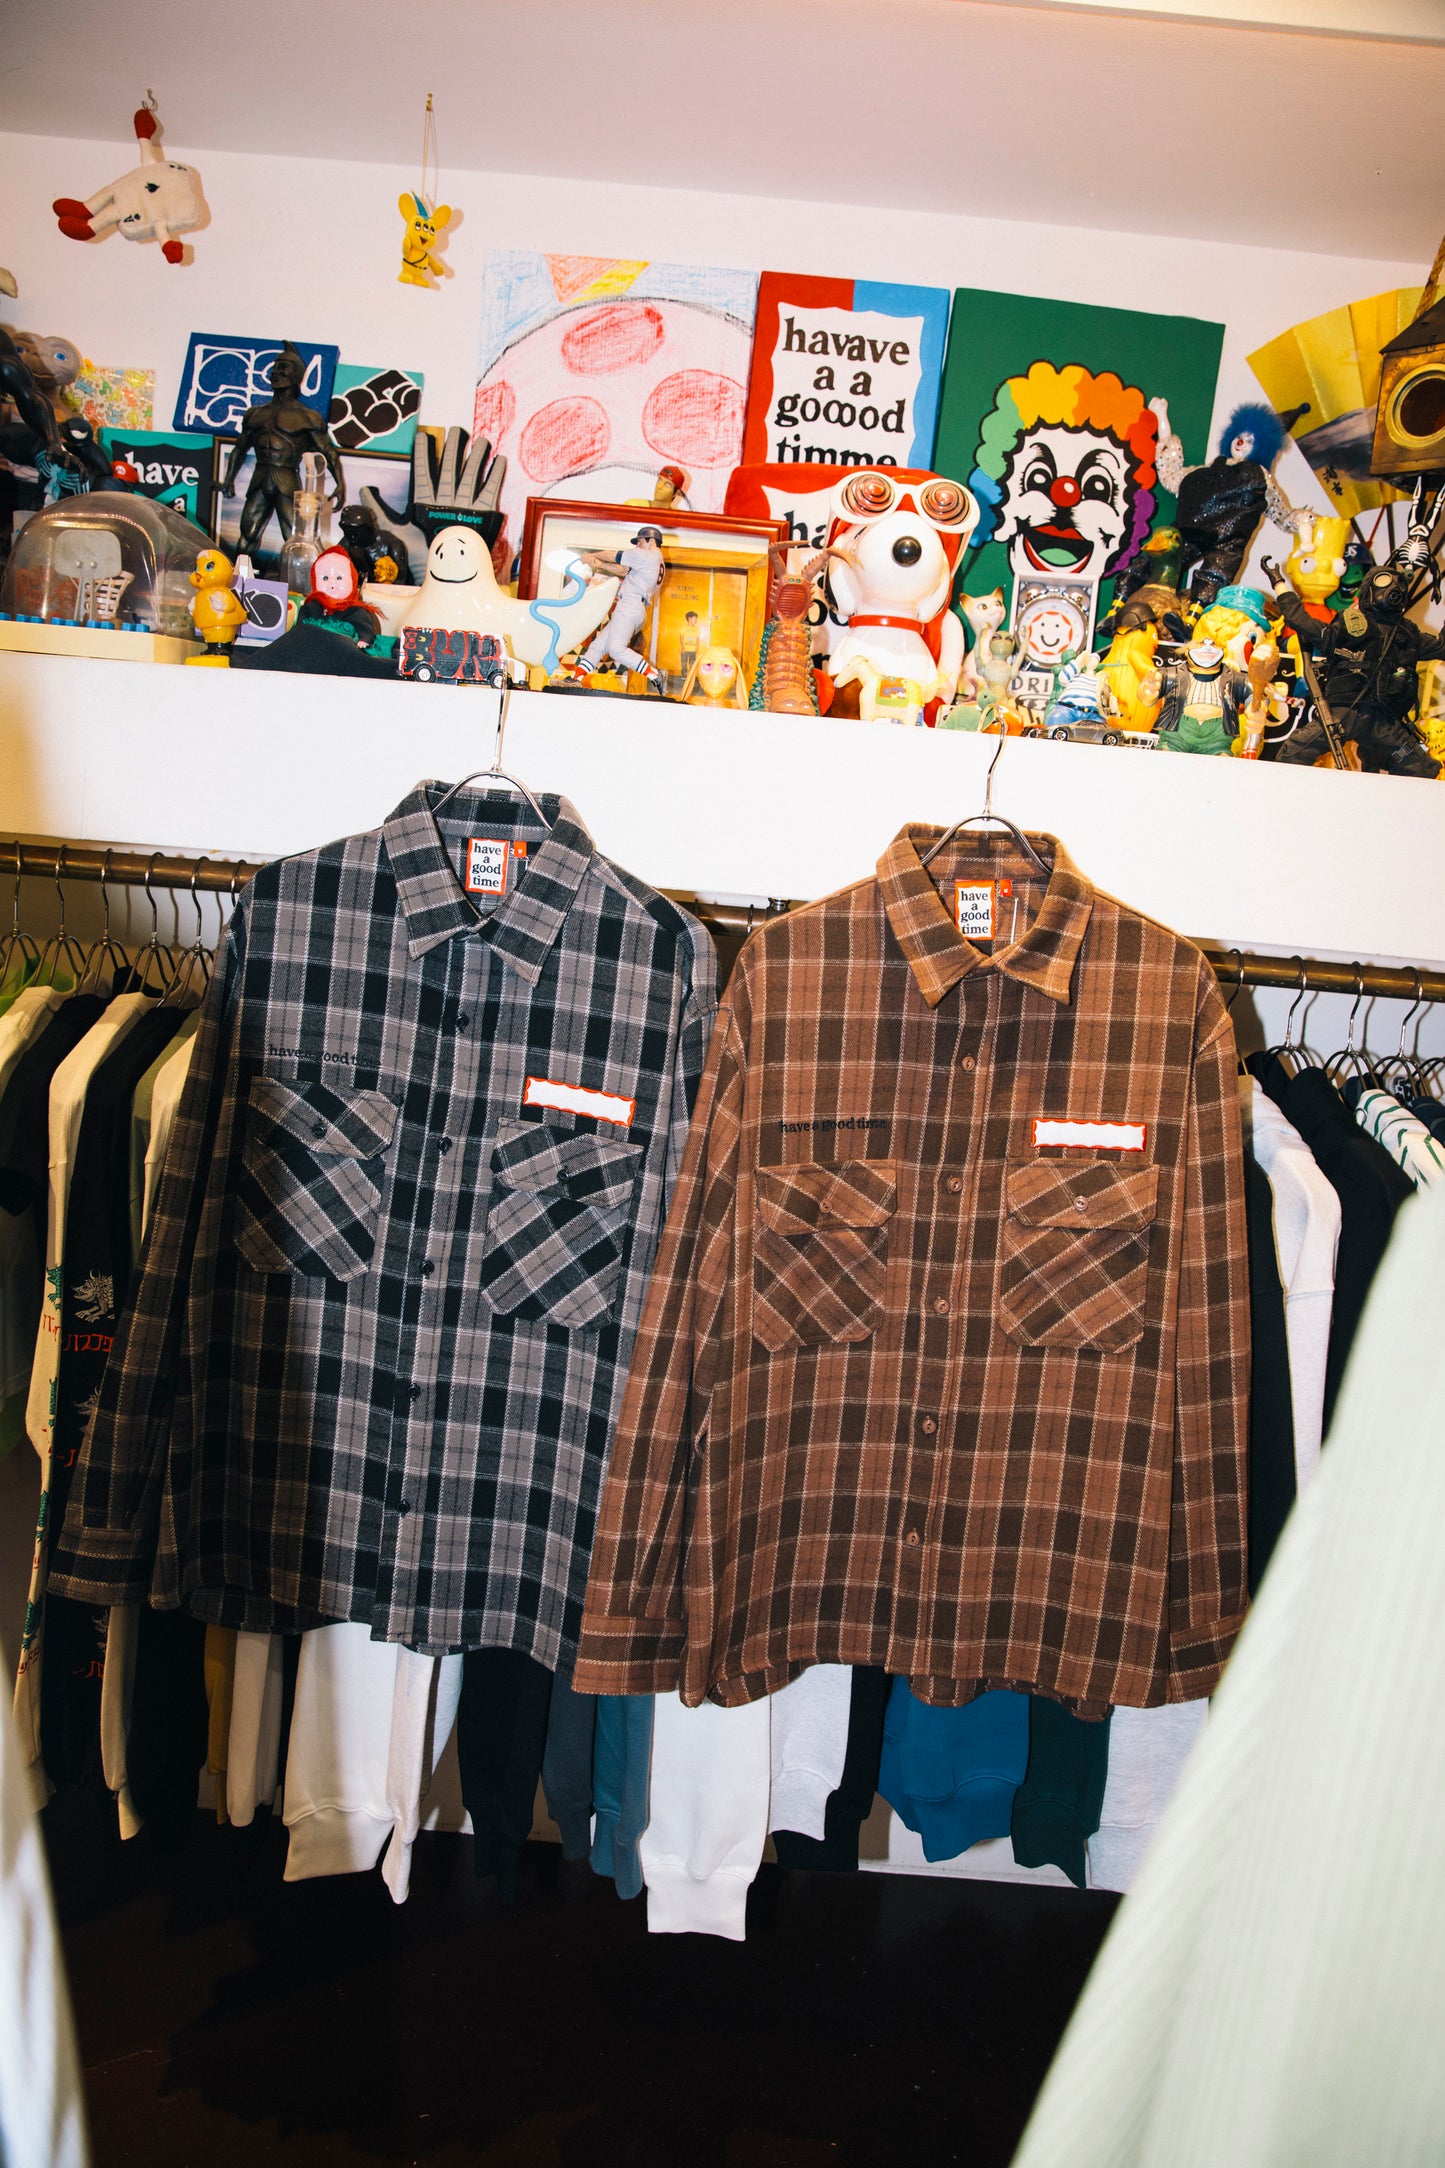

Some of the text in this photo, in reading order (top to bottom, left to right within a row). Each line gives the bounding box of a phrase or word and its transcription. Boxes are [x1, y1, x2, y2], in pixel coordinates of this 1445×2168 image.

[813, 365, 872, 397] a a
[124, 451, 199, 486] have
[173, 497, 186, 512] a
[428, 511, 457, 521] POWER
[655, 562, 665, 586] 8
[474, 843, 502, 856] have
[482, 855, 491, 864] a
[471, 863, 502, 875] good
[472, 875, 500, 888] time
[960, 890, 989, 902] have
[970, 902, 979, 911] a
[960, 909, 990, 923] good
[961, 923, 989, 935] time
[268, 1043, 301, 1057] have
[780, 1119, 810, 1133] have
[821, 1116, 855, 1132] good
[857, 1116, 887, 1130] time
